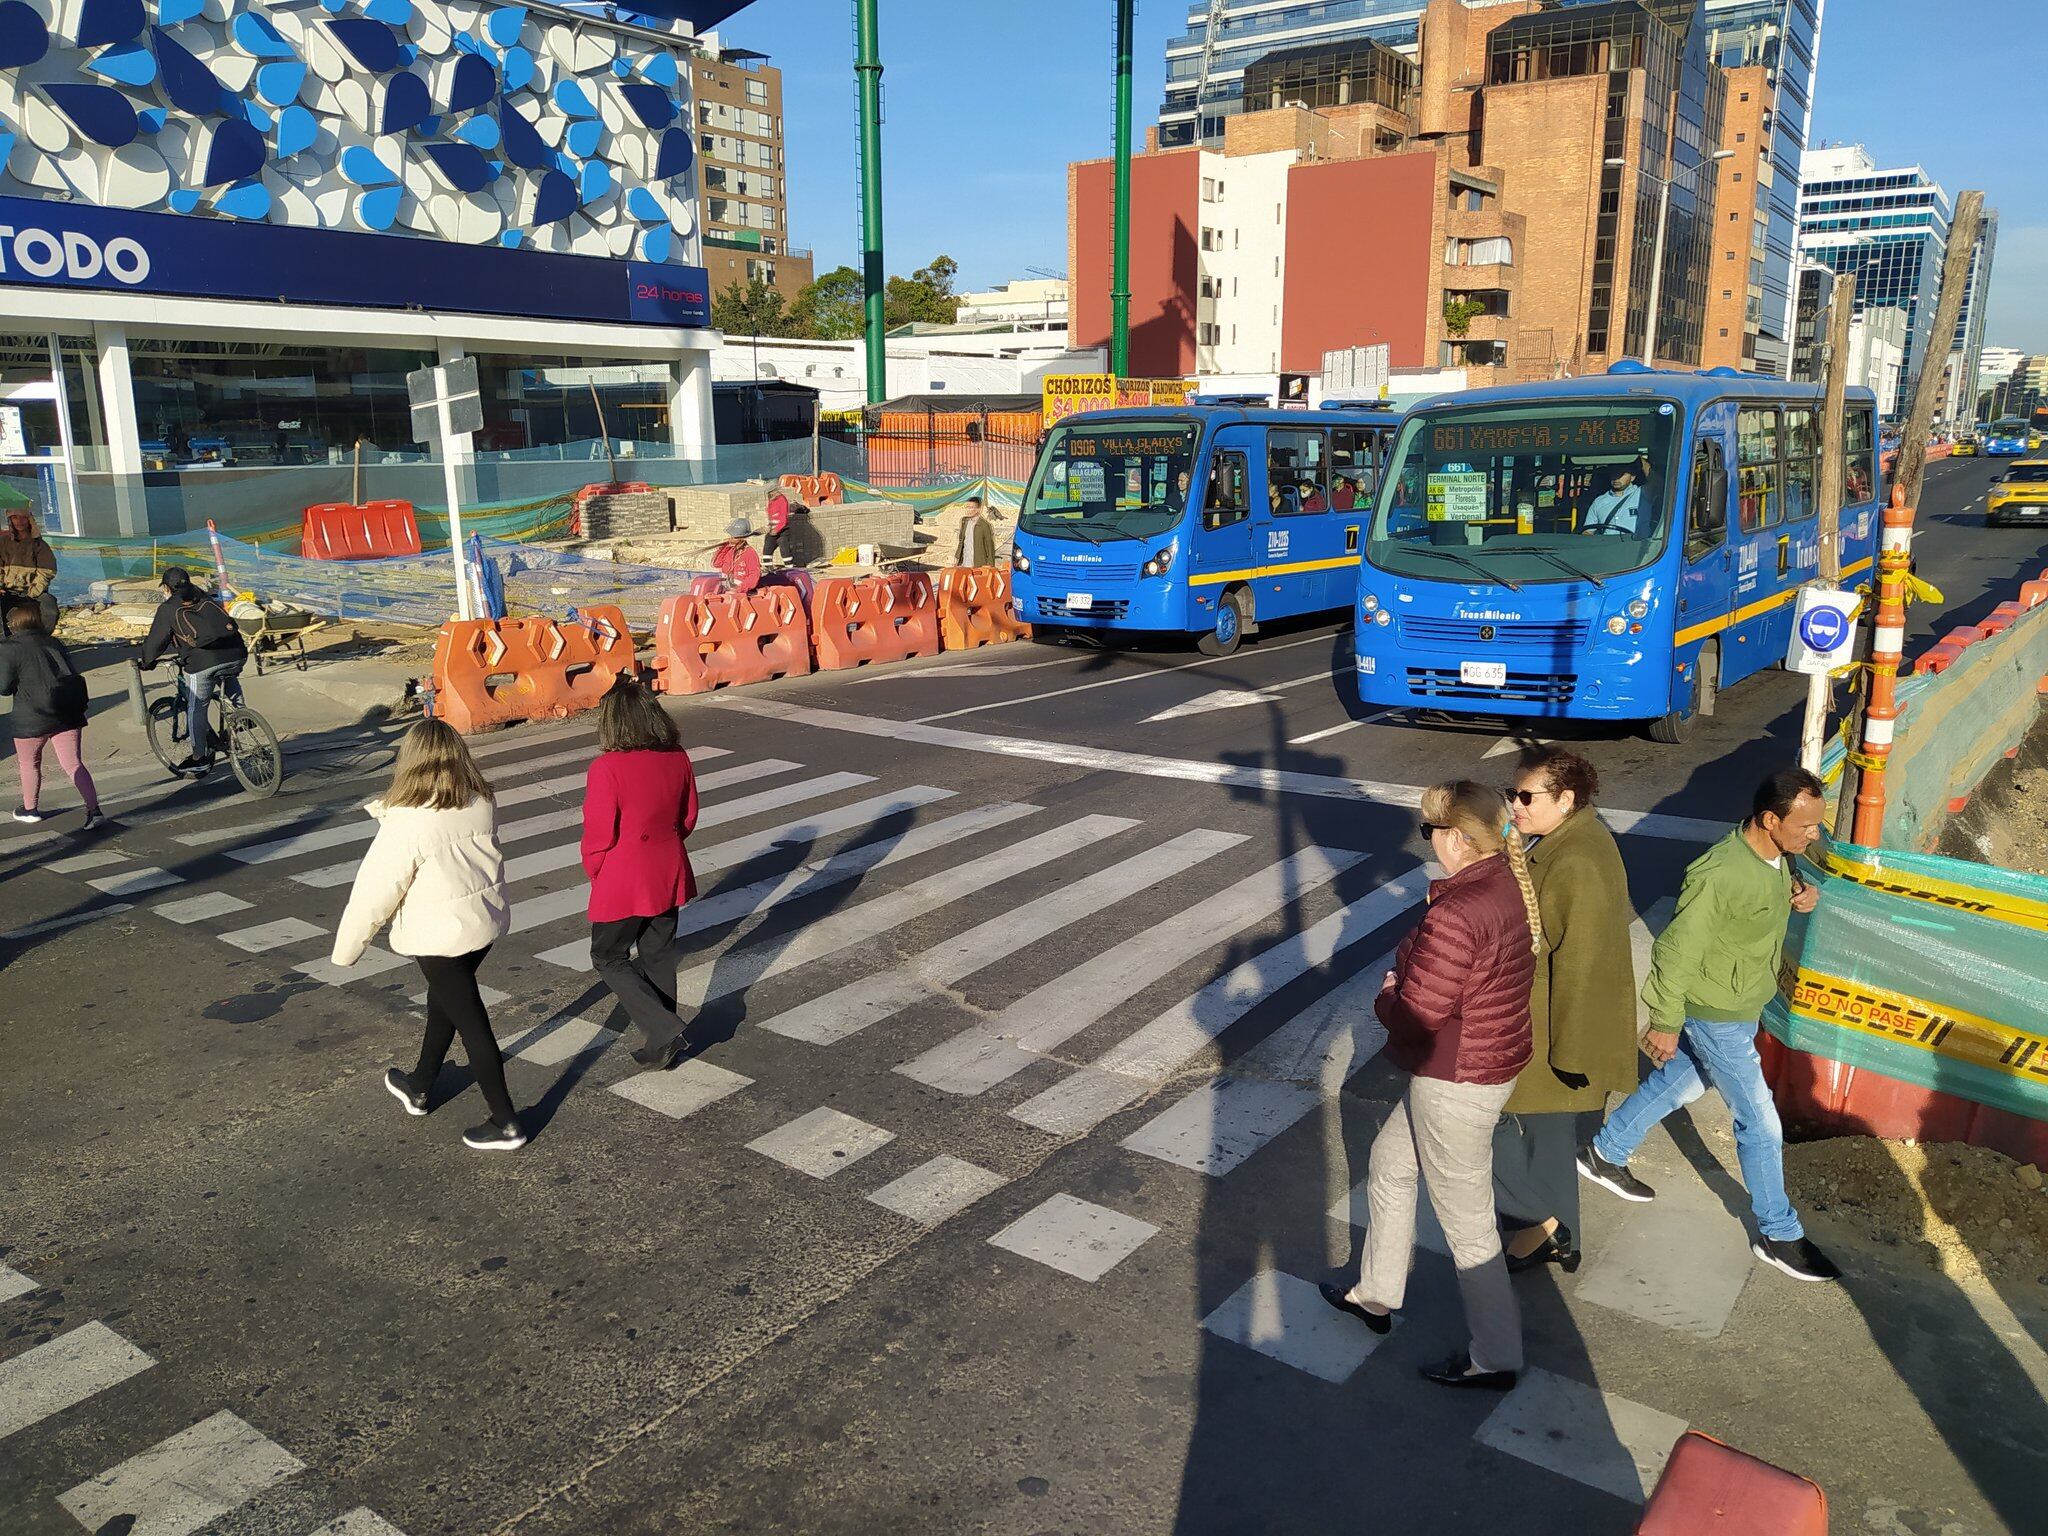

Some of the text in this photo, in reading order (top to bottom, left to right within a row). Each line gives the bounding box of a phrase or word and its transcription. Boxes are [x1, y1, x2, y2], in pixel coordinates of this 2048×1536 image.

[636, 284, 704, 304] 24 horas
[1152, 381, 1183, 395] SANDWICH
[1578, 420, 1605, 434] AK
[1616, 419, 1640, 433] 68
[1102, 436, 1183, 449] VILLA GLADYS
[1433, 427, 1464, 450] 661
[1070, 439, 1096, 456] D906
[1447, 463, 1466, 472] 661
[1429, 474, 1485, 483] TERMINAL NORTE
[1449, 485, 1483, 493] Metropólis
[1061, 554, 1102, 563] TransMilenio
[1459, 609, 1521, 621] TransMilenio
[1484, 667, 1504, 679] 635
[1836, 999, 1864, 1016] NO
[1868, 1007, 1918, 1031] PASE
